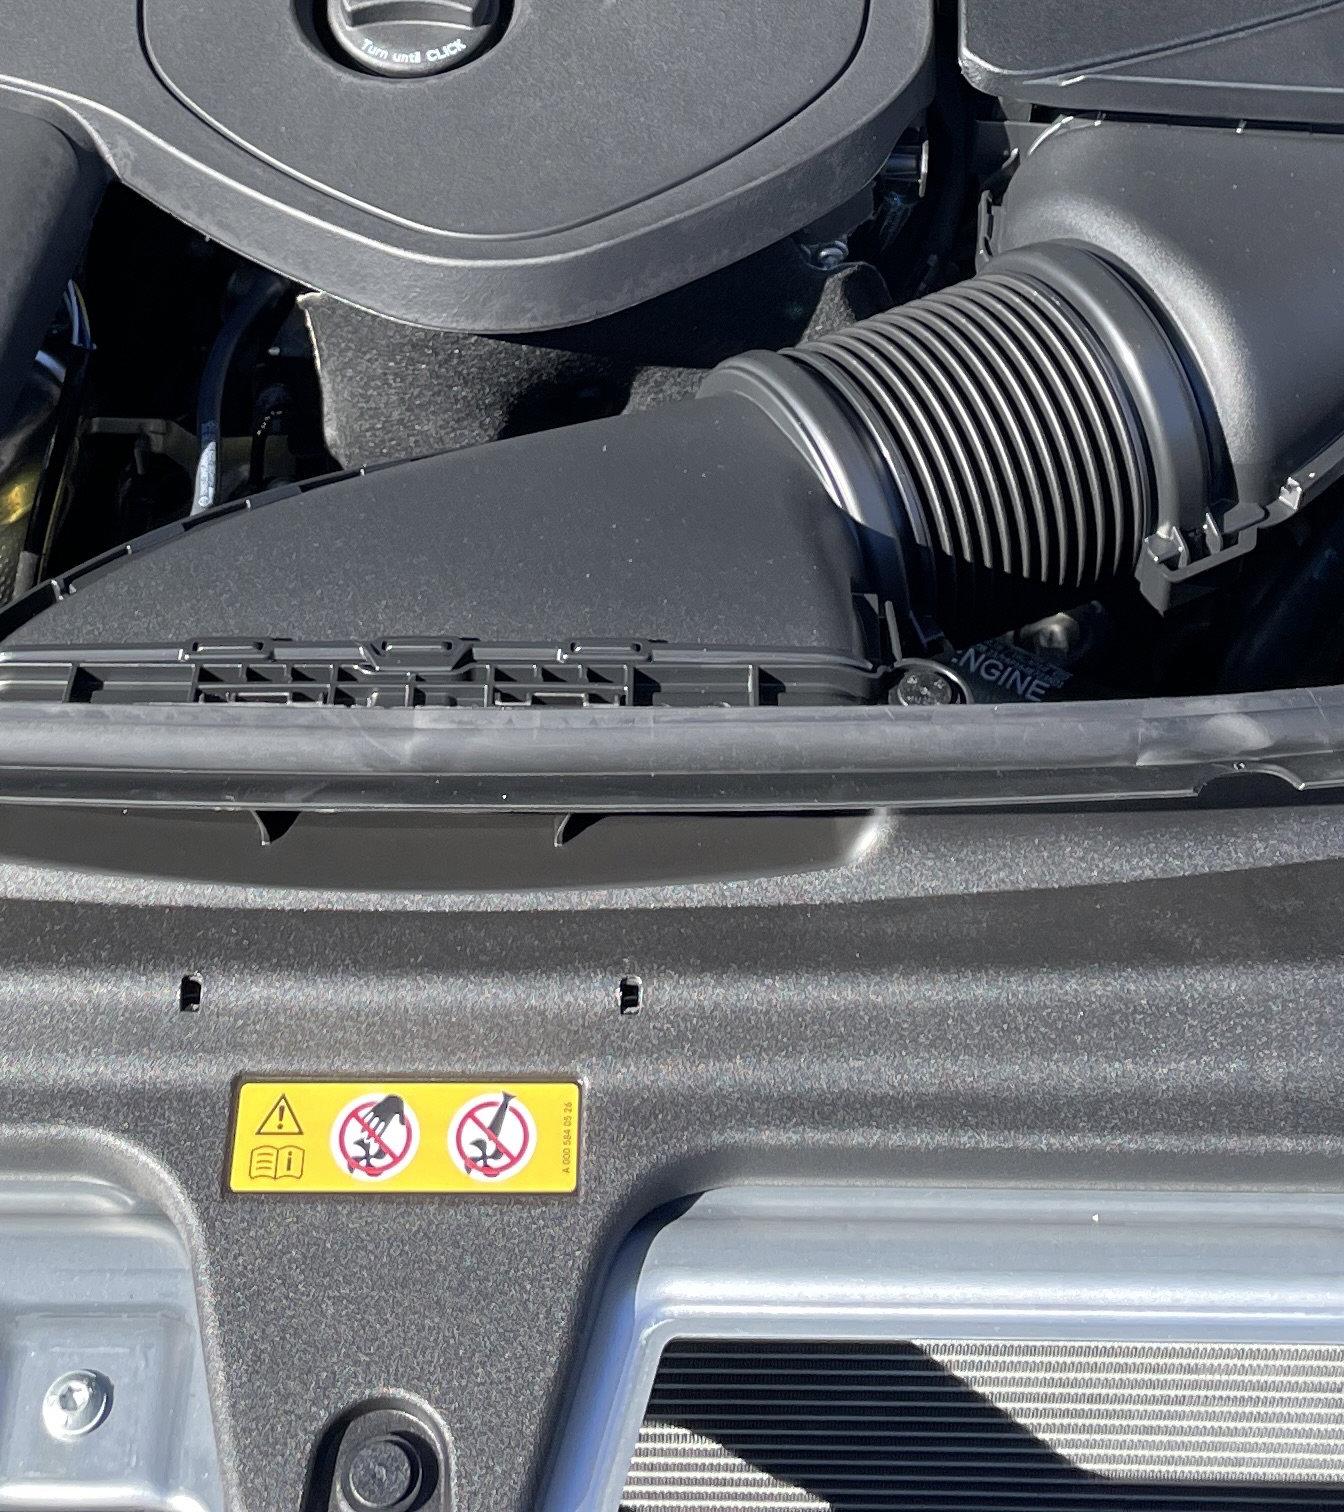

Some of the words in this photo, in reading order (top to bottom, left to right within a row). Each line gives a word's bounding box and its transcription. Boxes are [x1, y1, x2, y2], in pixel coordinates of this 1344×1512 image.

[361, 38, 389, 59] Turn
[392, 51, 421, 63] until
[426, 38, 467, 62] CLICK
[951, 648, 1050, 702] NGINE
